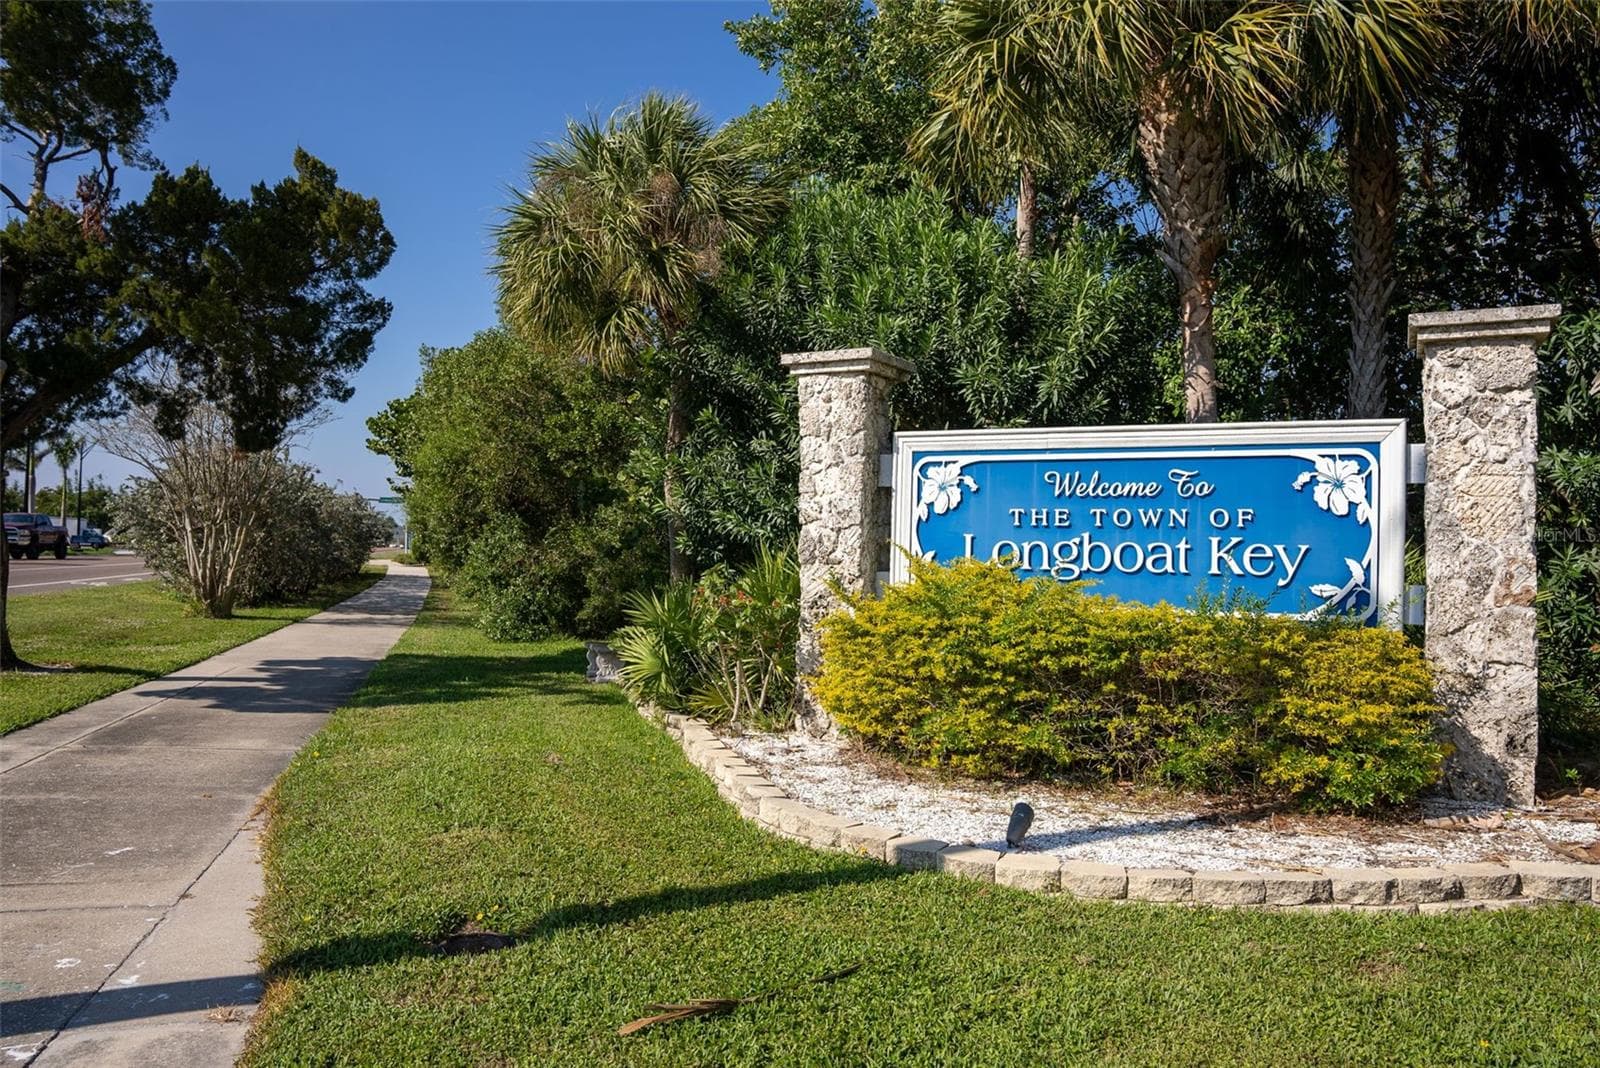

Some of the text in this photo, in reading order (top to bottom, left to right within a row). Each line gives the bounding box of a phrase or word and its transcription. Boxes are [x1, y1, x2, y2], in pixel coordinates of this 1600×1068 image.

[1044, 468, 1215, 499] Welcome To
[1008, 508, 1255, 529] THE TOWN OF
[1207, 536, 1310, 588] Key
